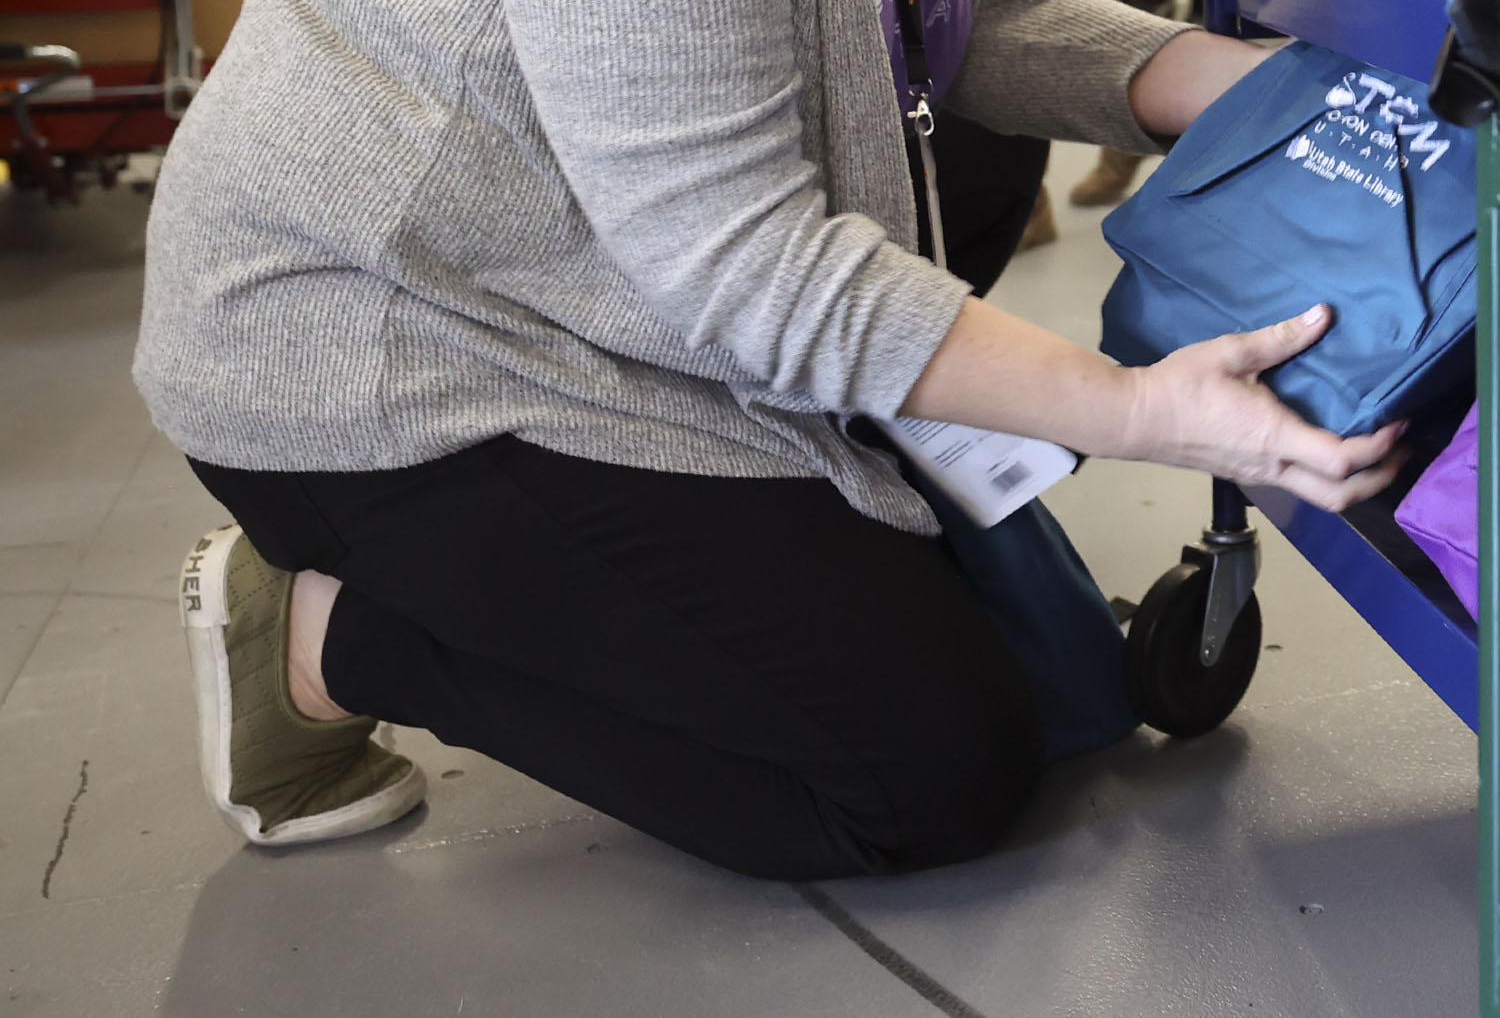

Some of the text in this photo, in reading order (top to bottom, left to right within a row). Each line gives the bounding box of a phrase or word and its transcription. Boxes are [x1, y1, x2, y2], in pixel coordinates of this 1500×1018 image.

[1325, 72, 1451, 172] STEM
[1308, 145, 1404, 208] Utah State Library
